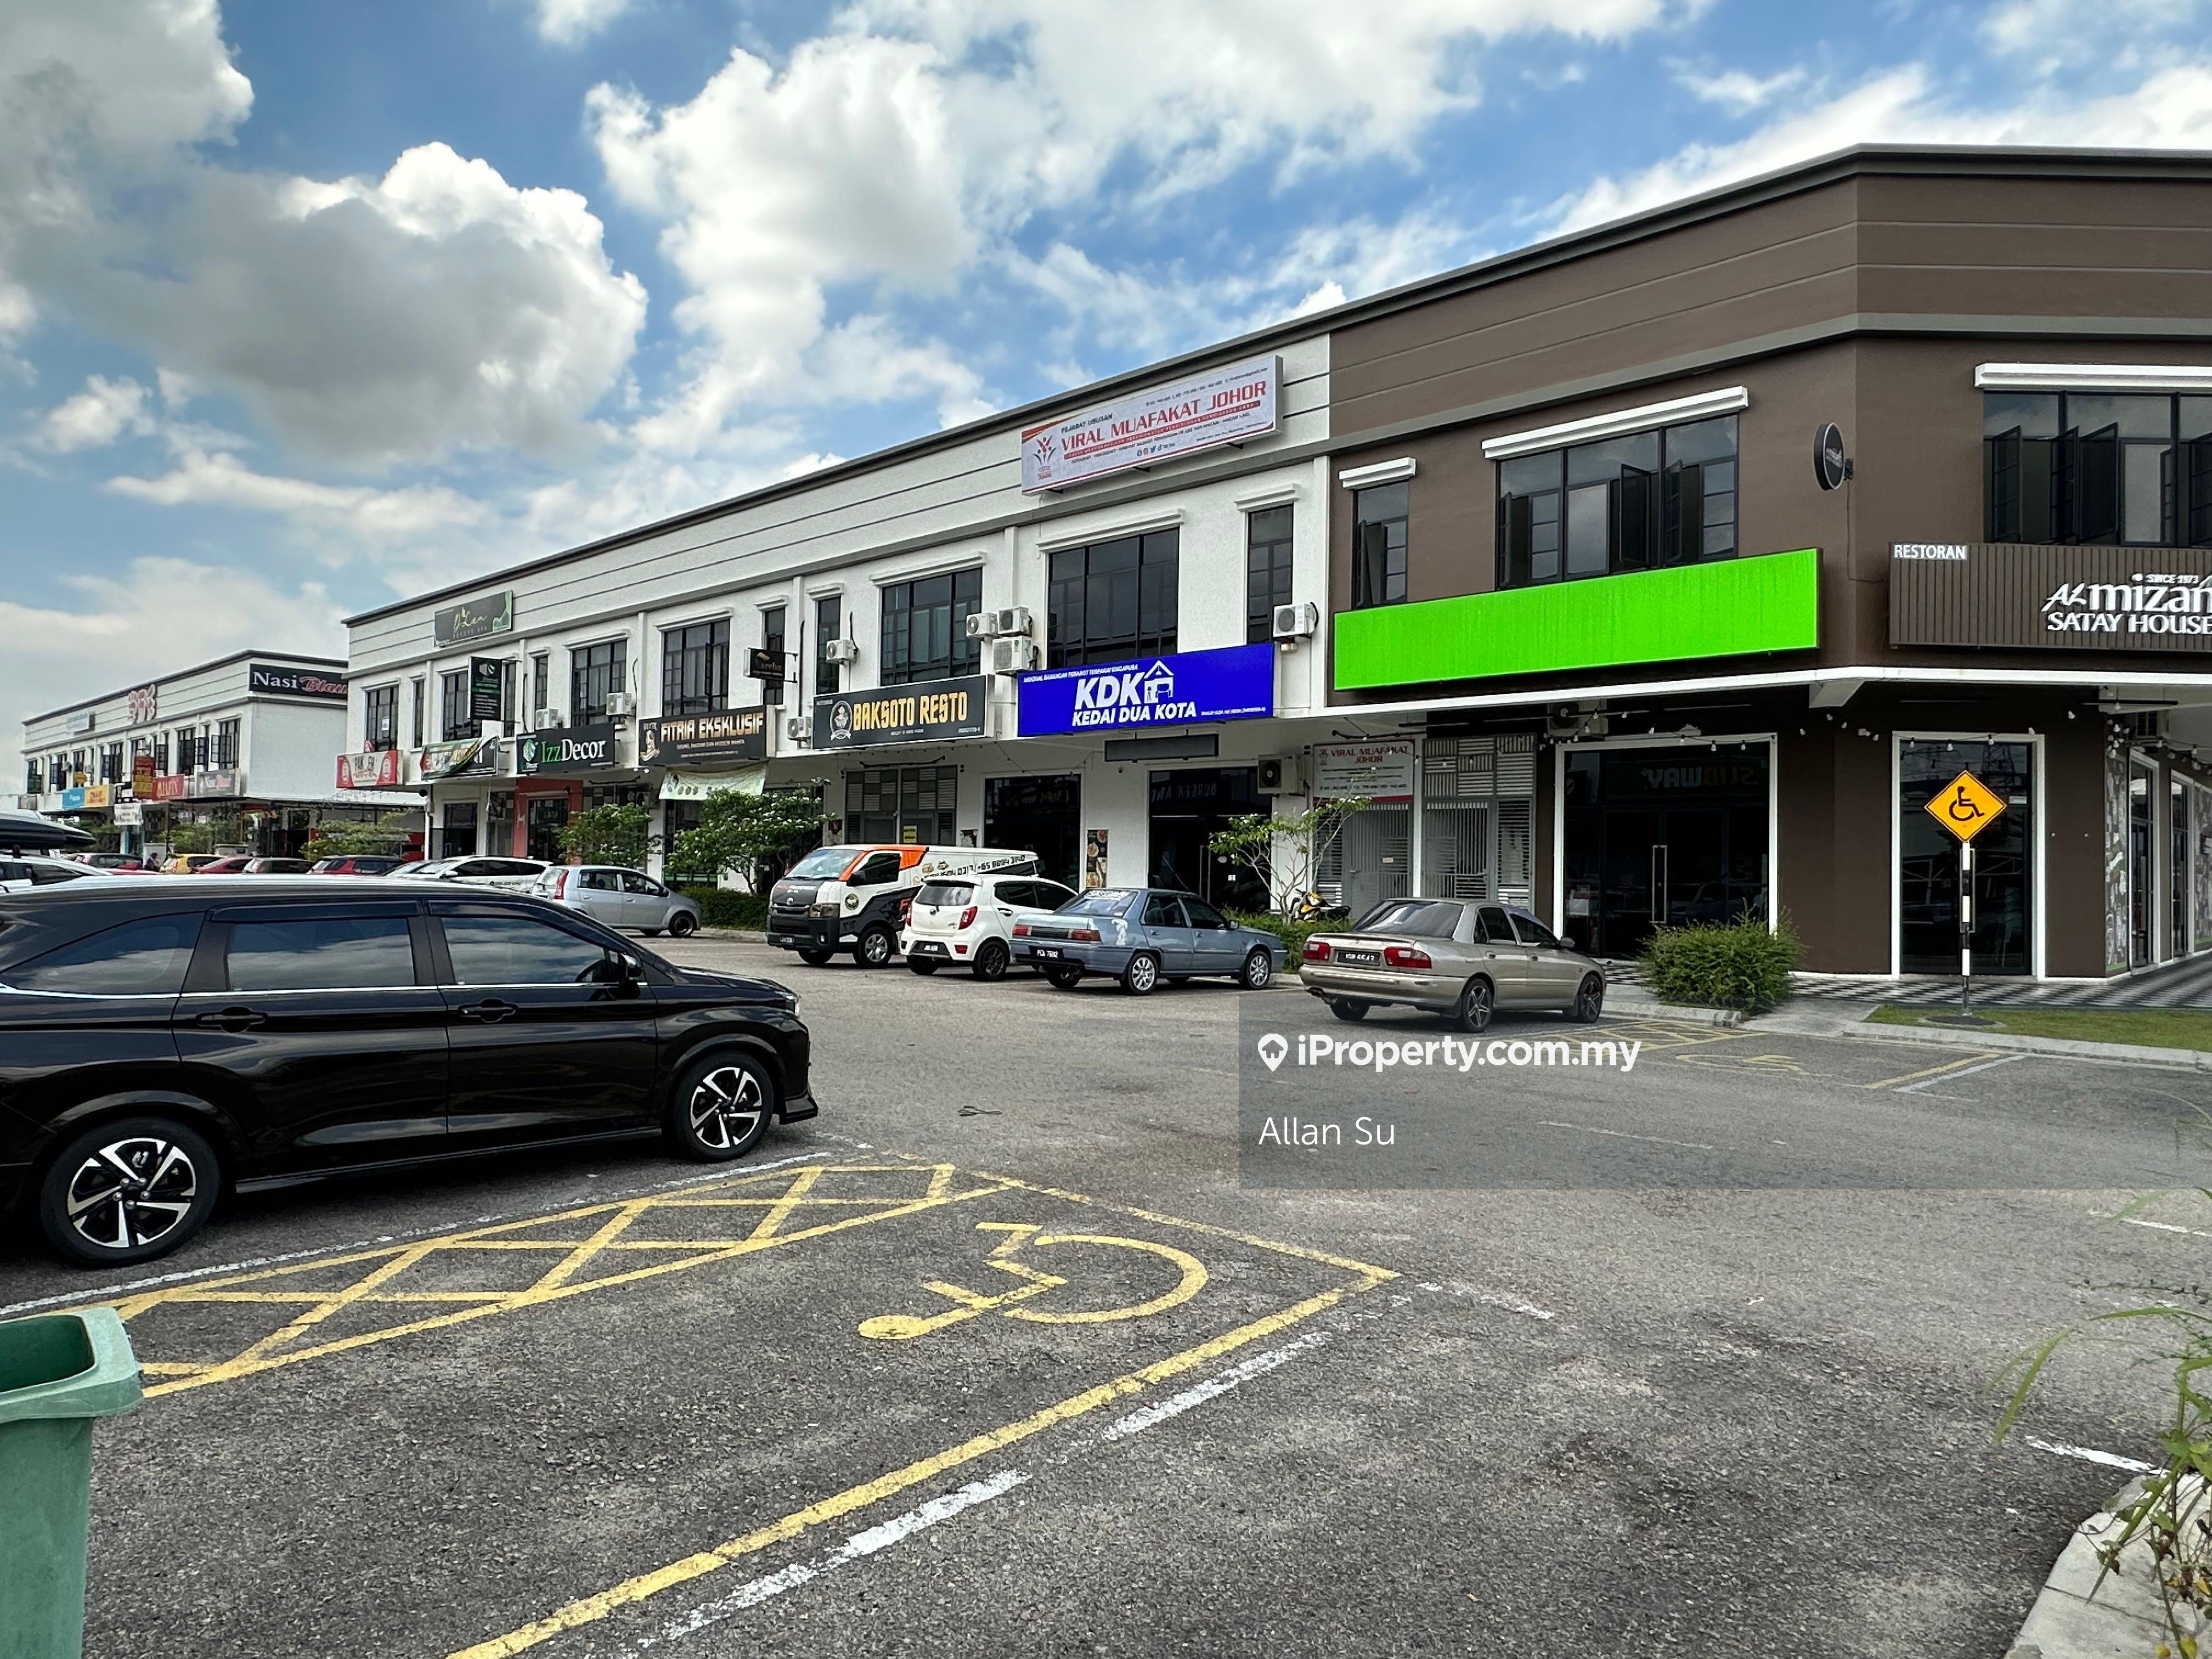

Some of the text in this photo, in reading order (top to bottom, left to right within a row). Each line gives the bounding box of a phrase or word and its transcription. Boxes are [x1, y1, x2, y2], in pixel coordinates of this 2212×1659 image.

[1062, 428, 1105, 451] VIRAL
[1111, 399, 1201, 438] MUAFAKAT
[1206, 381, 1266, 411] JOHOR
[1062, 421, 1086, 433] PEJABAT
[1894, 544, 1966, 560] RESTORAN
[2146, 574, 2198, 584] SINCE 1973
[2047, 612, 2212, 634] SATAY HOUSE
[251, 672, 298, 689] Nasi
[1075, 672, 1145, 710] KDK
[854, 692, 967, 731] BAKSOTO RESTO
[1072, 708, 1116, 726] KEDAI
[1118, 706, 1150, 723] DUA
[1154, 702, 1197, 720] KOTA
[661, 712, 764, 743] FITRIA EKSKLUSIF
